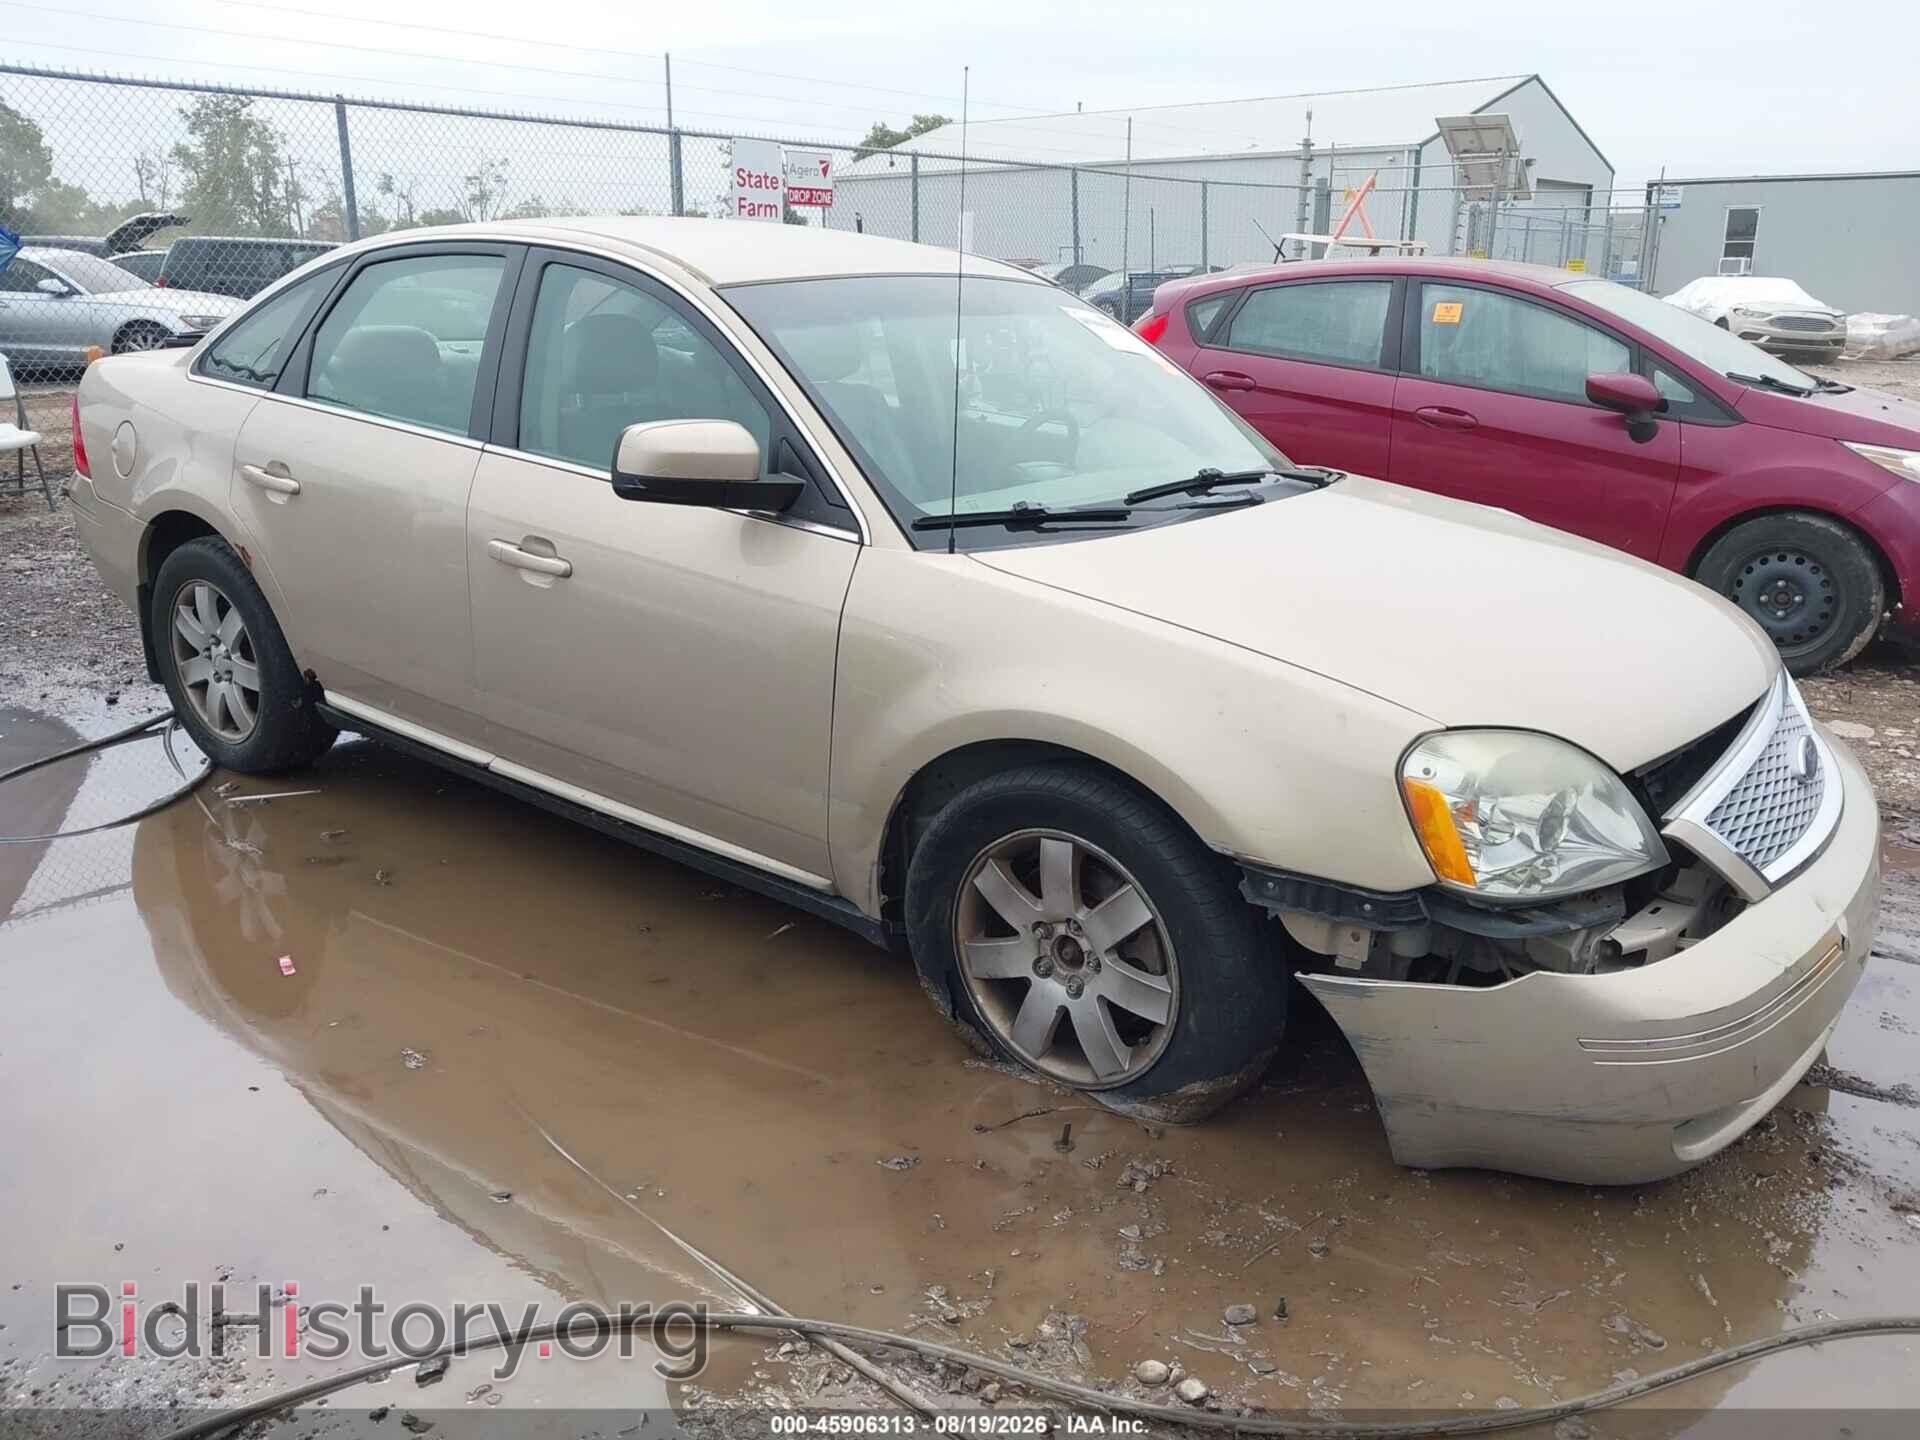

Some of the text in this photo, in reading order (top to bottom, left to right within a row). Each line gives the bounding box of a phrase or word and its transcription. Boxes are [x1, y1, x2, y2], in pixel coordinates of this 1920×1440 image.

[736, 167, 779, 190] State
[789, 162, 819, 179] Agero
[788, 189, 832, 204] DROP ZONE
[737, 197, 778, 218] Farm
